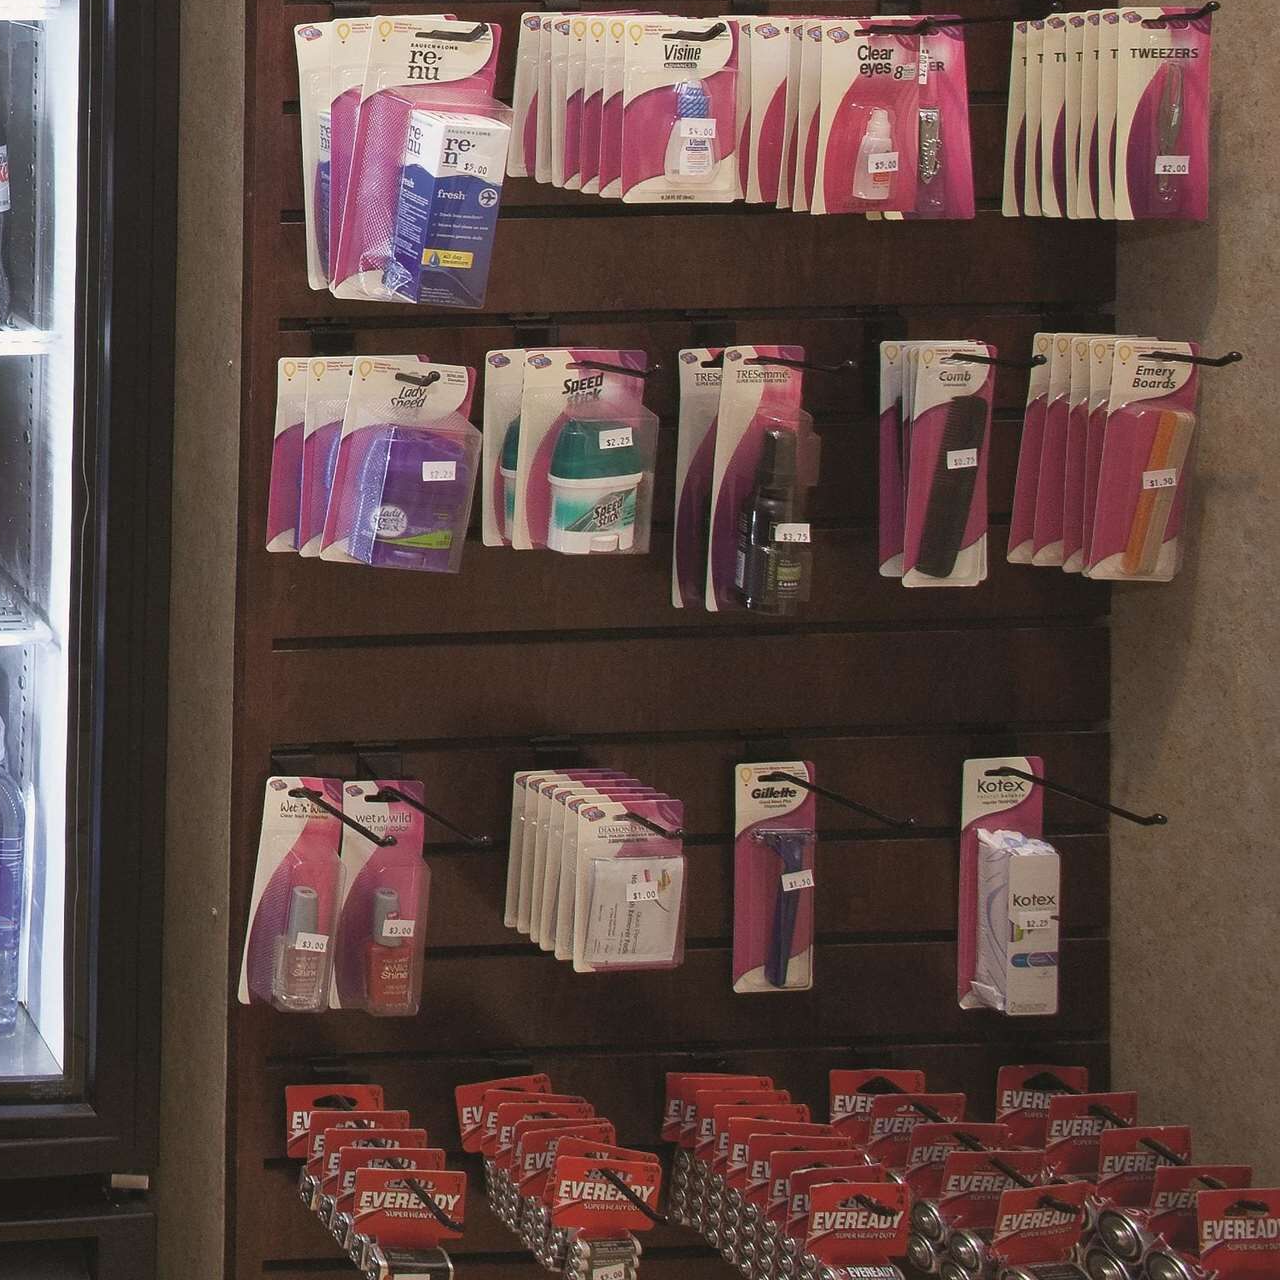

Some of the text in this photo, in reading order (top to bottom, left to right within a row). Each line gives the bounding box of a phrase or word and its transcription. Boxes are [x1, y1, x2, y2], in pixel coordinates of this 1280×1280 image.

[664, 44, 701, 61] Visine
[857, 45, 894, 62] Clear
[1130, 48, 1199, 59] TWEEZERS
[860, 60, 892, 75] eyes
[1162, 164, 1186, 173] $2.00
[437, 189, 465, 200] fresh
[939, 370, 971, 382] Comb
[1136, 366, 1175, 380] Emery
[1132, 378, 1176, 390] Boards
[399, 386, 426, 400] Lady
[751, 786, 796, 799] Gillette
[977, 779, 1024, 793] kotex
[632, 890, 656, 900] $1.00
[1012, 893, 1055, 906] kotex
[390, 927, 411, 935] $3.00
[302, 942, 325, 950] $3.00
[813, 1213, 902, 1230] EVEREADY
